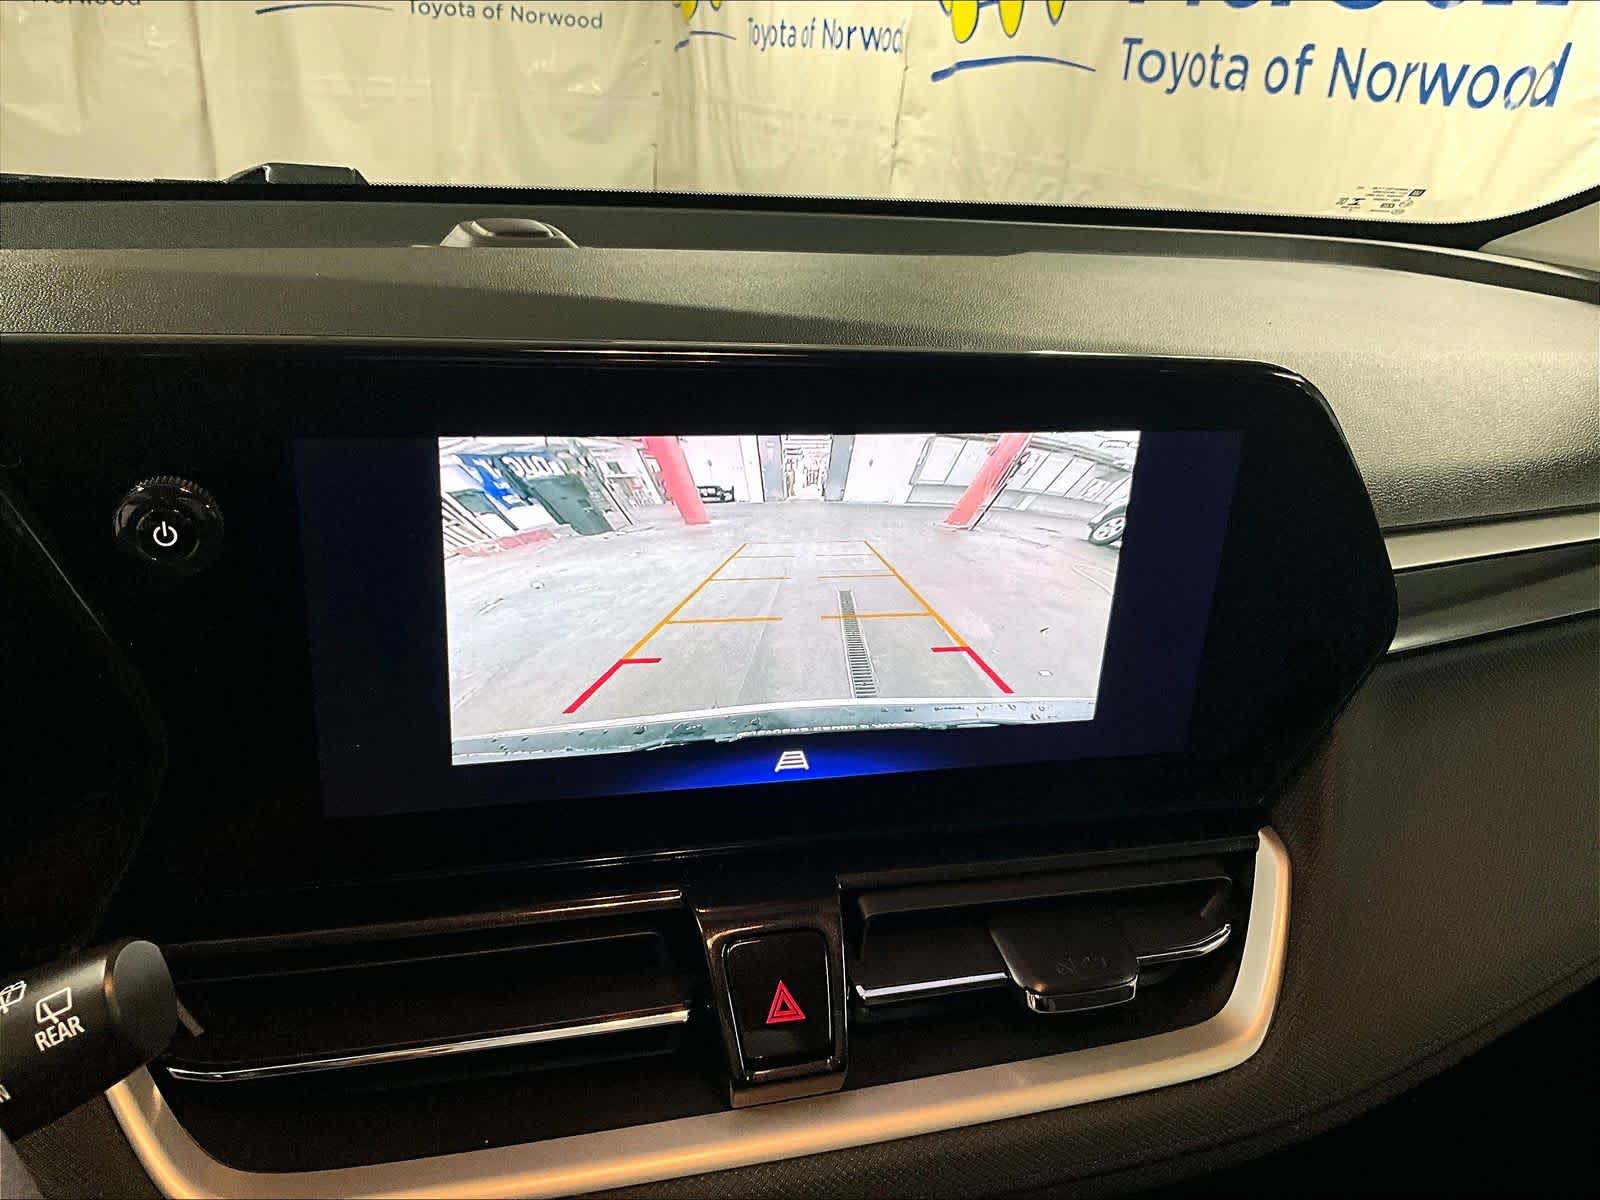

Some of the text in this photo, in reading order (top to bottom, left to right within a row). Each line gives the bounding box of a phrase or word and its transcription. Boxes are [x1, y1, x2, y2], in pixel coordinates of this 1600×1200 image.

[409, 0, 603, 29] Toyota of Norwood
[748, 17, 797, 52] Toyota
[800, 18, 816, 49] of
[1122, 37, 1573, 110] Toyota of Norwood
[34, 1015, 86, 1052] REAR
